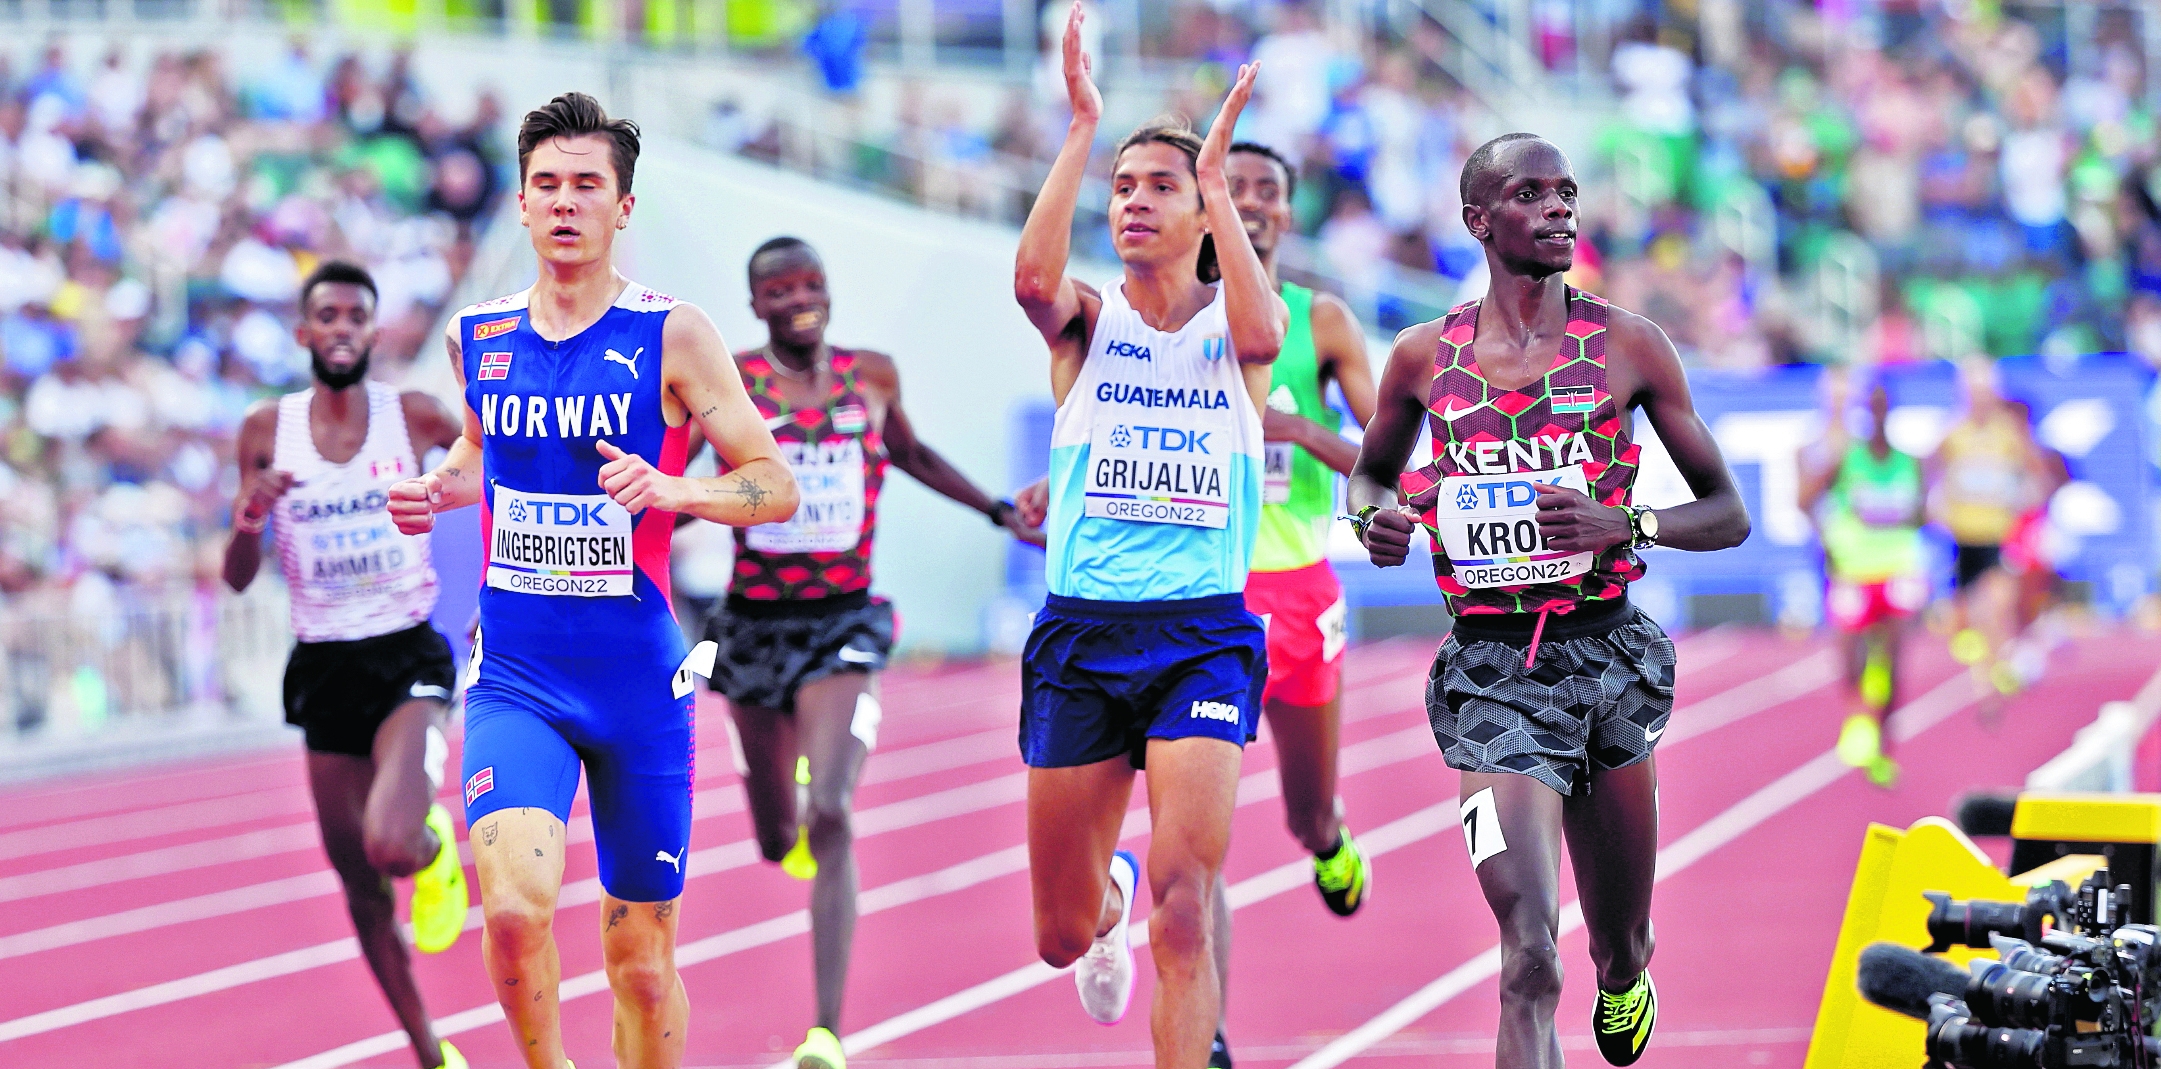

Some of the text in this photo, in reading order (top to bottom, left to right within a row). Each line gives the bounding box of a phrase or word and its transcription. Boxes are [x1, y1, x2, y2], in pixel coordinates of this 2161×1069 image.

[1106, 340, 1151, 362] HOKA
[1096, 382, 1230, 410] GUATEMALA
[482, 392, 633, 438] NORWAY
[1132, 425, 1213, 455] TDK
[1449, 431, 1595, 475] KENYA
[1095, 458, 1222, 497] GRIJALVA
[526, 500, 609, 527] TDK
[1105, 501, 1206, 523] OREGON22
[496, 528, 626, 567] INGEBRIGTSEN
[1466, 519, 1553, 557] KRO
[510, 574, 608, 593] OREGON22
[1464, 560, 1572, 585] OREGON22
[1190, 700, 1240, 726] HOKA
